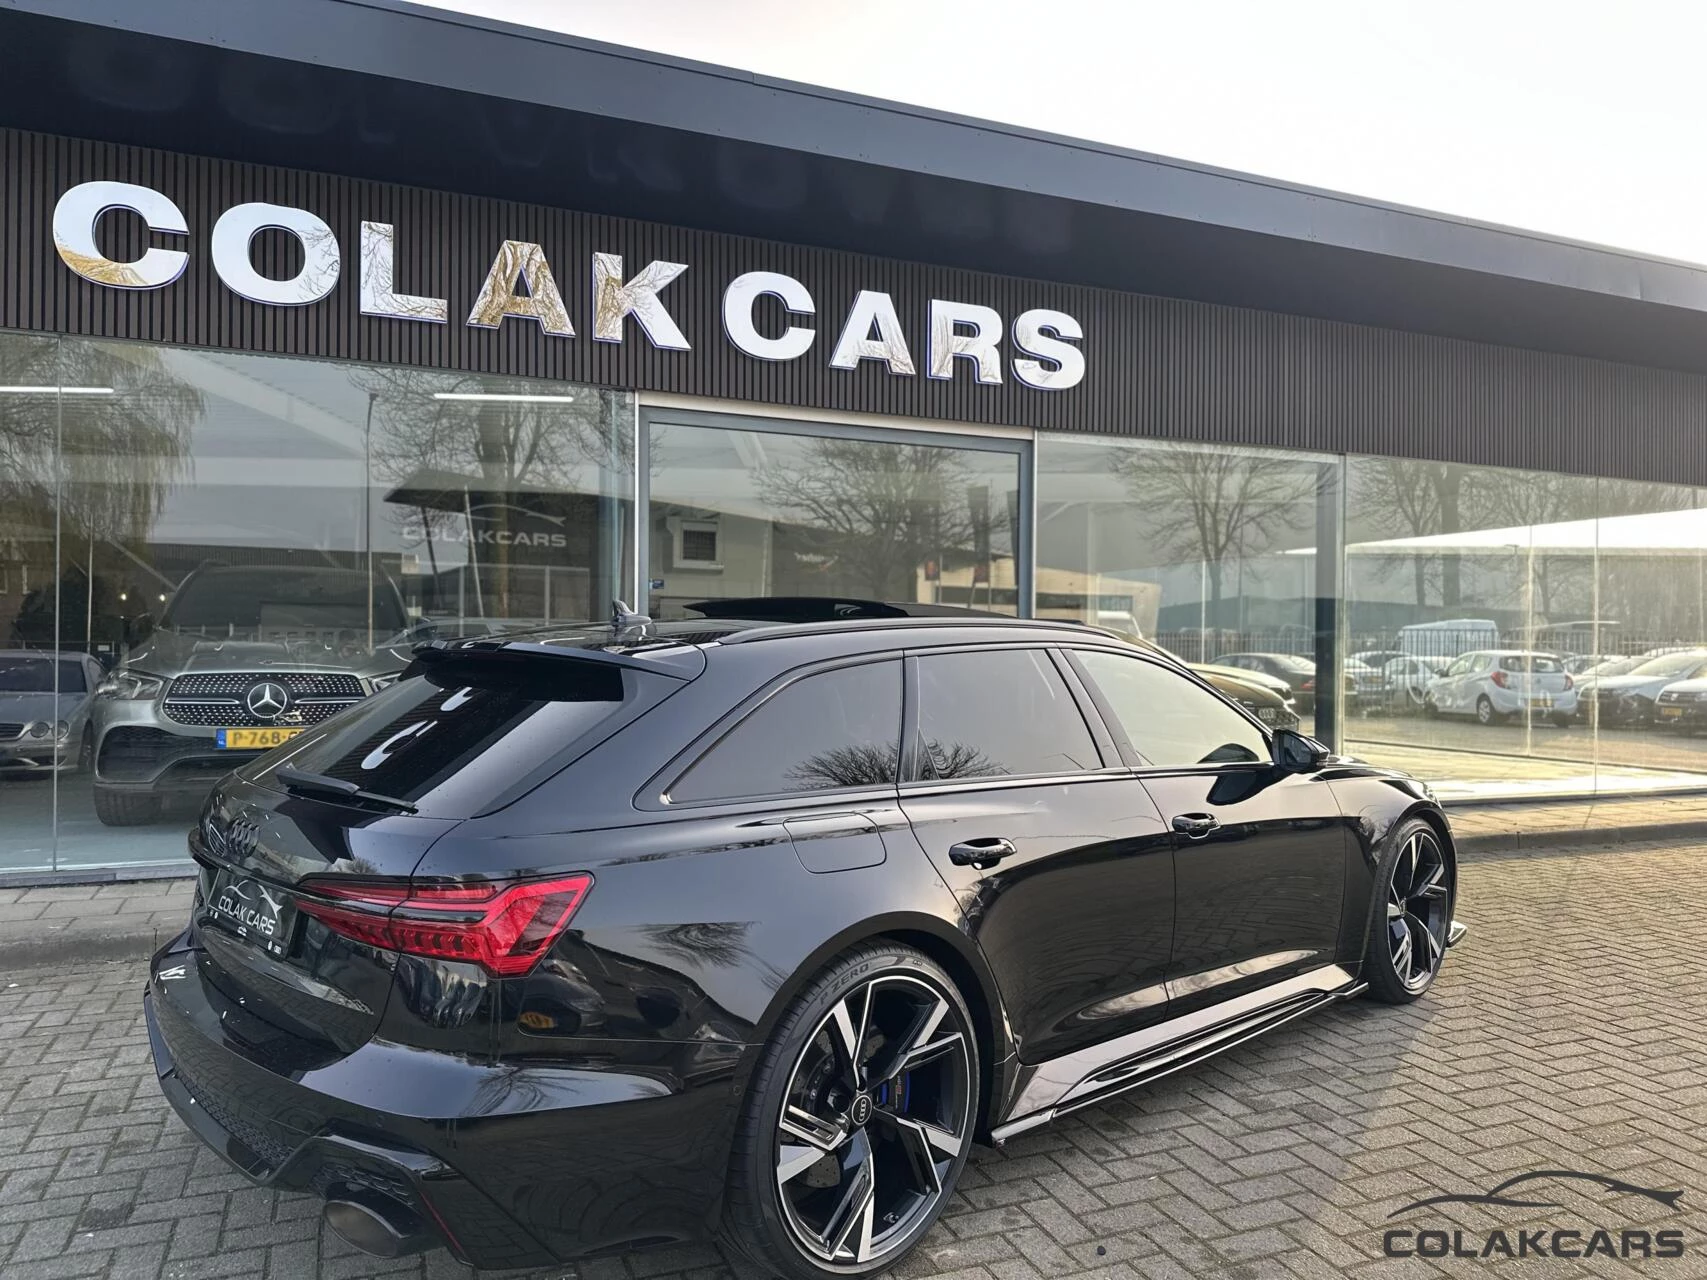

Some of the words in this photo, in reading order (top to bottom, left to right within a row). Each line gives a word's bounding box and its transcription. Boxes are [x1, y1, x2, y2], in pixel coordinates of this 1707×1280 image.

[403, 526, 567, 547] COLAKCARS
[232, 731, 304, 746] P-768-
[218, 895, 247, 922] COLAK
[246, 909, 276, 935] CARS
[831, 963, 870, 994] ZERO
